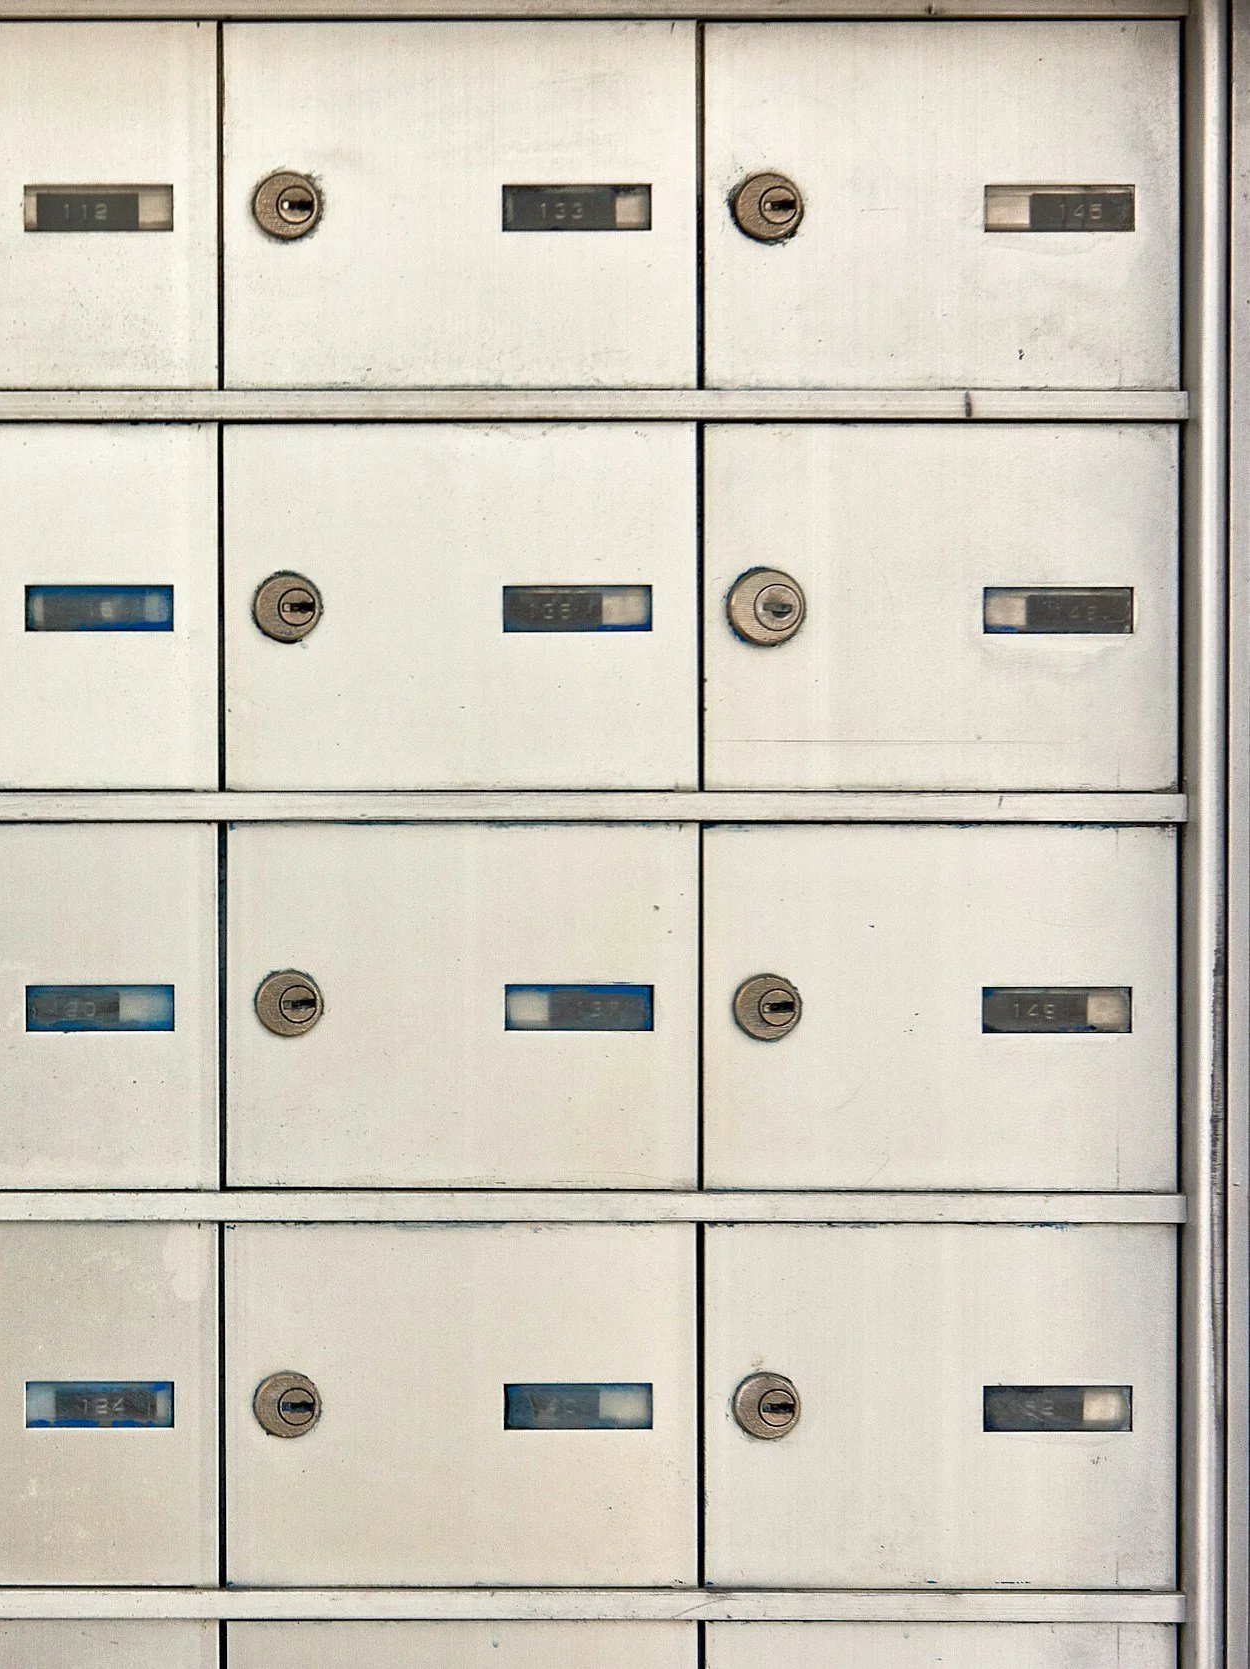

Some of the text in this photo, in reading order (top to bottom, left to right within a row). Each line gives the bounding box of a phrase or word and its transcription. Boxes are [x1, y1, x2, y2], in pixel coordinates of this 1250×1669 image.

[63, 203, 108, 221] 112
[540, 202, 584, 220] 133
[1058, 203, 1103, 220] 145
[83, 1397, 126, 1415] 124
